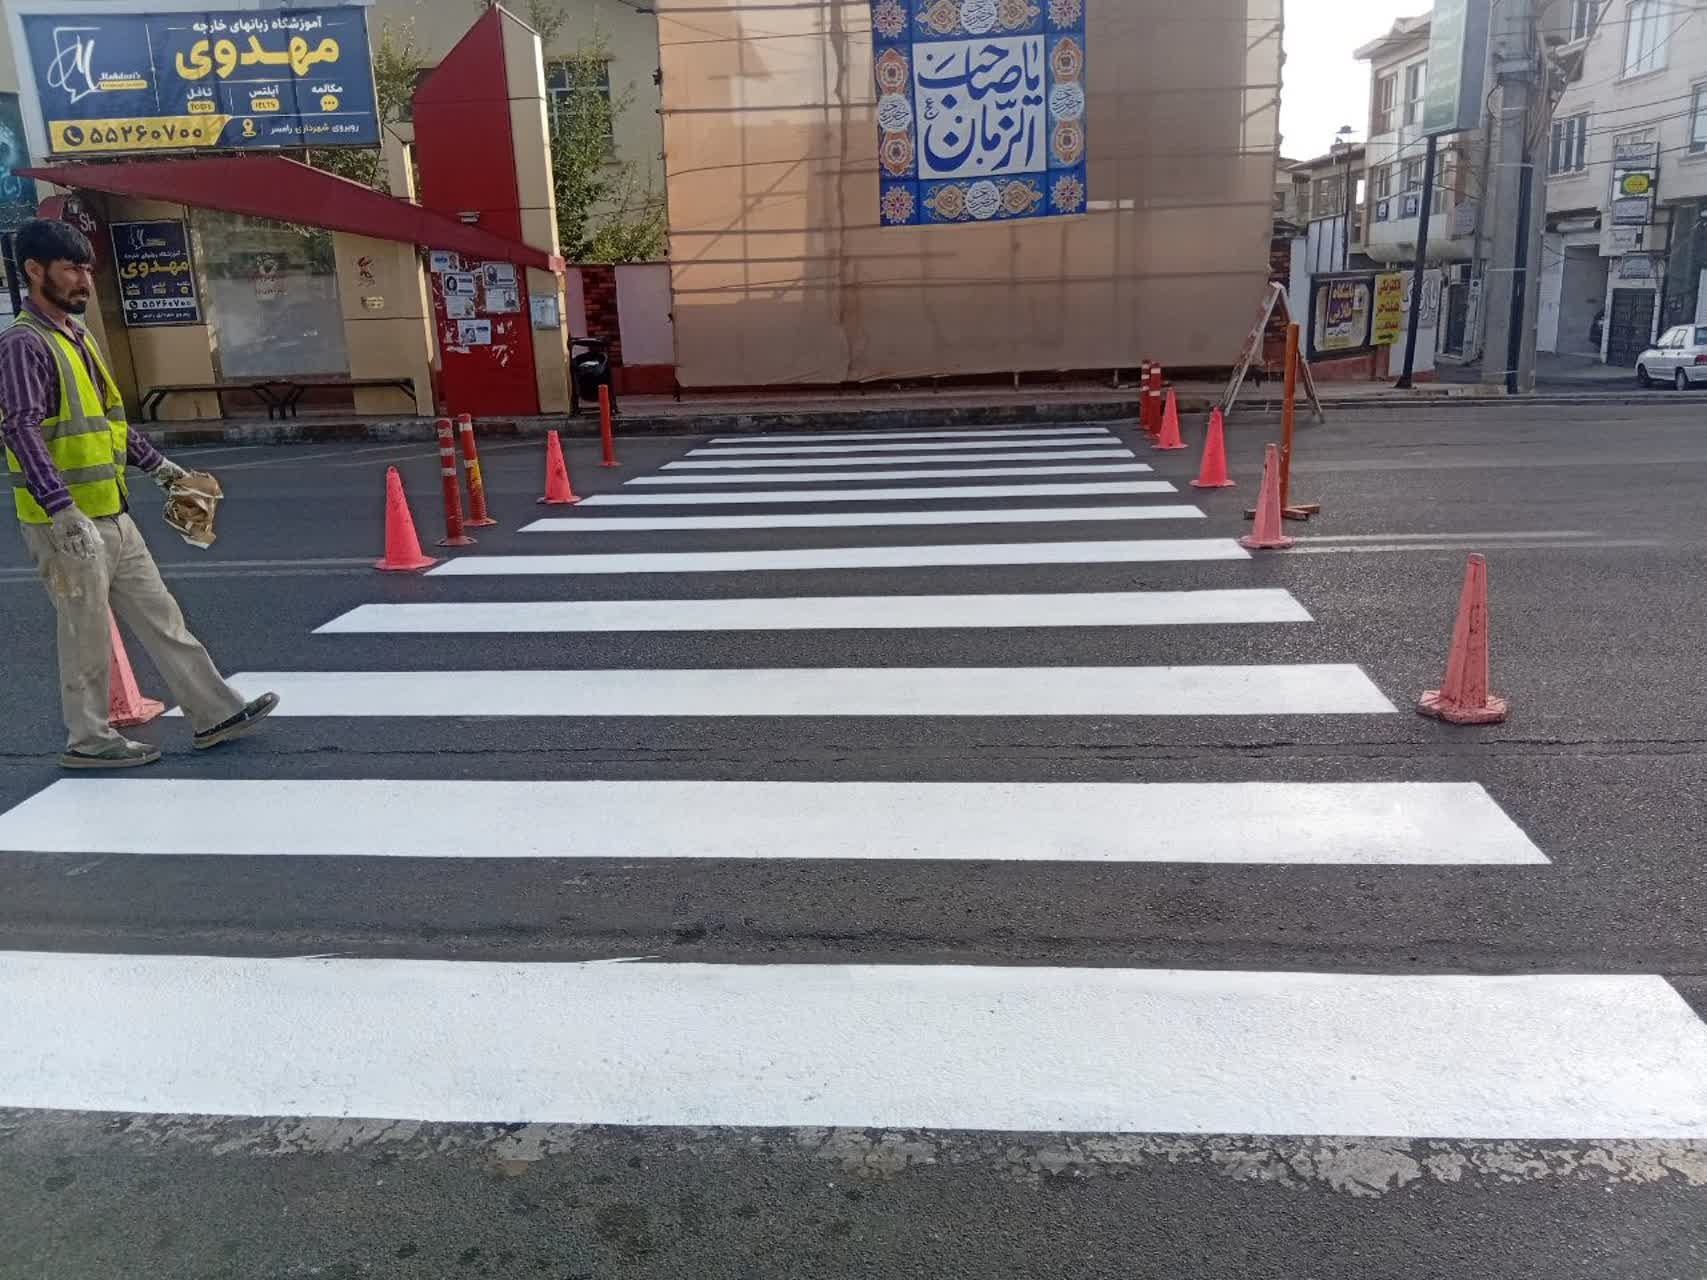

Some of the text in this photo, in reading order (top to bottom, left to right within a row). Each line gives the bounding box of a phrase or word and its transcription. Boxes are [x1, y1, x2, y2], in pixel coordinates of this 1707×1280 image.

[192, 15, 322, 34] آموزشگاه زبانهای خارجه
[175, 34, 340, 80] مهدوی
[917, 44, 1022, 109] صاحب
[186, 86, 213, 100] تافل
[248, 85, 279, 98] آیلتس
[311, 84, 344, 94] مکالمه
[254, 101, 276, 109] IELTS
[89, 123, 203, 144] ۵۵۲۶۰۷۰۰
[295, 125, 330, 135] شهرداری
[331, 124, 360, 133] روبروی
[120, 259, 188, 279] مهدوی
[142, 299, 192, 308] ۵۵۲۶۰۷۰۰
